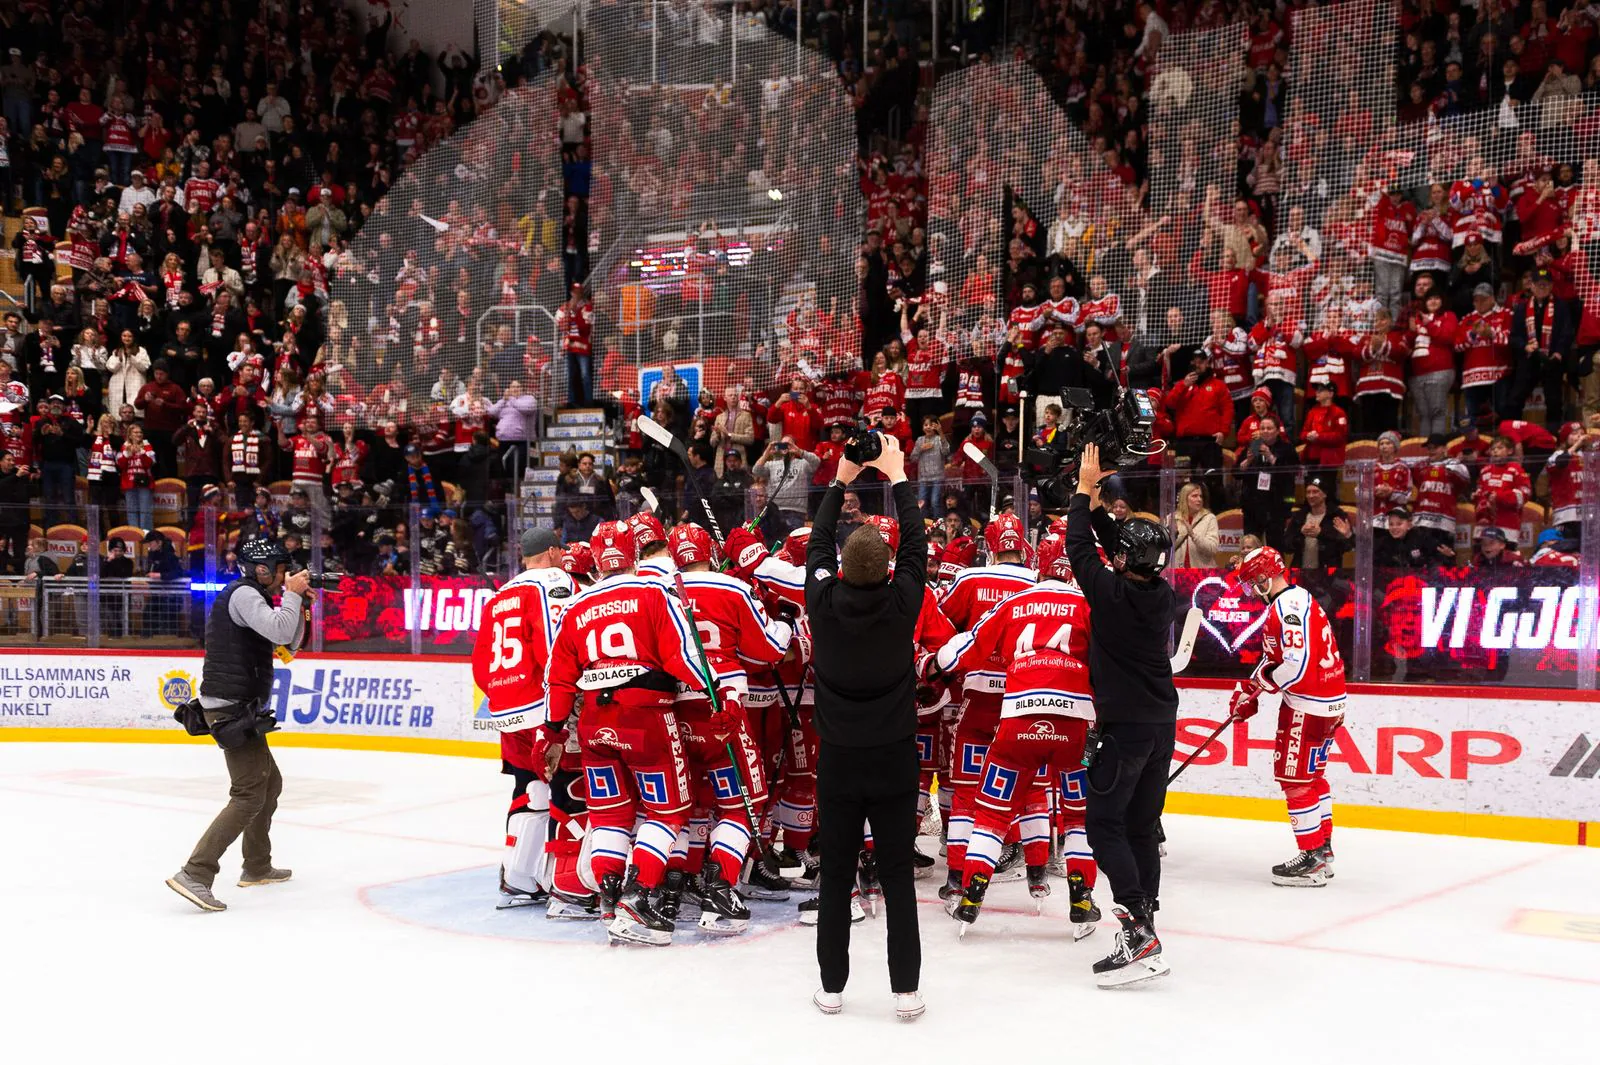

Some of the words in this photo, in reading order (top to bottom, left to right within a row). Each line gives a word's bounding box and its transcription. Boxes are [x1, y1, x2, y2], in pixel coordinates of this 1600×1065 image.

[1004, 540, 1015, 549] 24
[608, 558, 620, 568] 19
[682, 552, 695, 562] 78
[404, 588, 433, 631] VI
[576, 599, 639, 631] ANDERSSON
[1012, 602, 1077, 619] BLOMQVIST
[1420, 586, 1476, 649] VI
[1479, 586, 1600, 649] GJO
[585, 621, 638, 663] 19
[1013, 623, 1073, 661] 44
[1284, 629, 1304, 649] 33
[111, 665, 131, 682] ÄR
[584, 667, 641, 685] BILBOLAGET
[29, 682, 110, 699] OMÖJLIGA
[1015, 698, 1075, 711] BILBOLAGET
[409, 705, 434, 728] AB
[1017, 732, 1070, 742] PROLYMPIA
[1285, 710, 1305, 768] PEAB
[666, 724, 689, 791] PEAB
[1171, 716, 1522, 781] SHARP
[740, 785, 762, 837] BAUER
